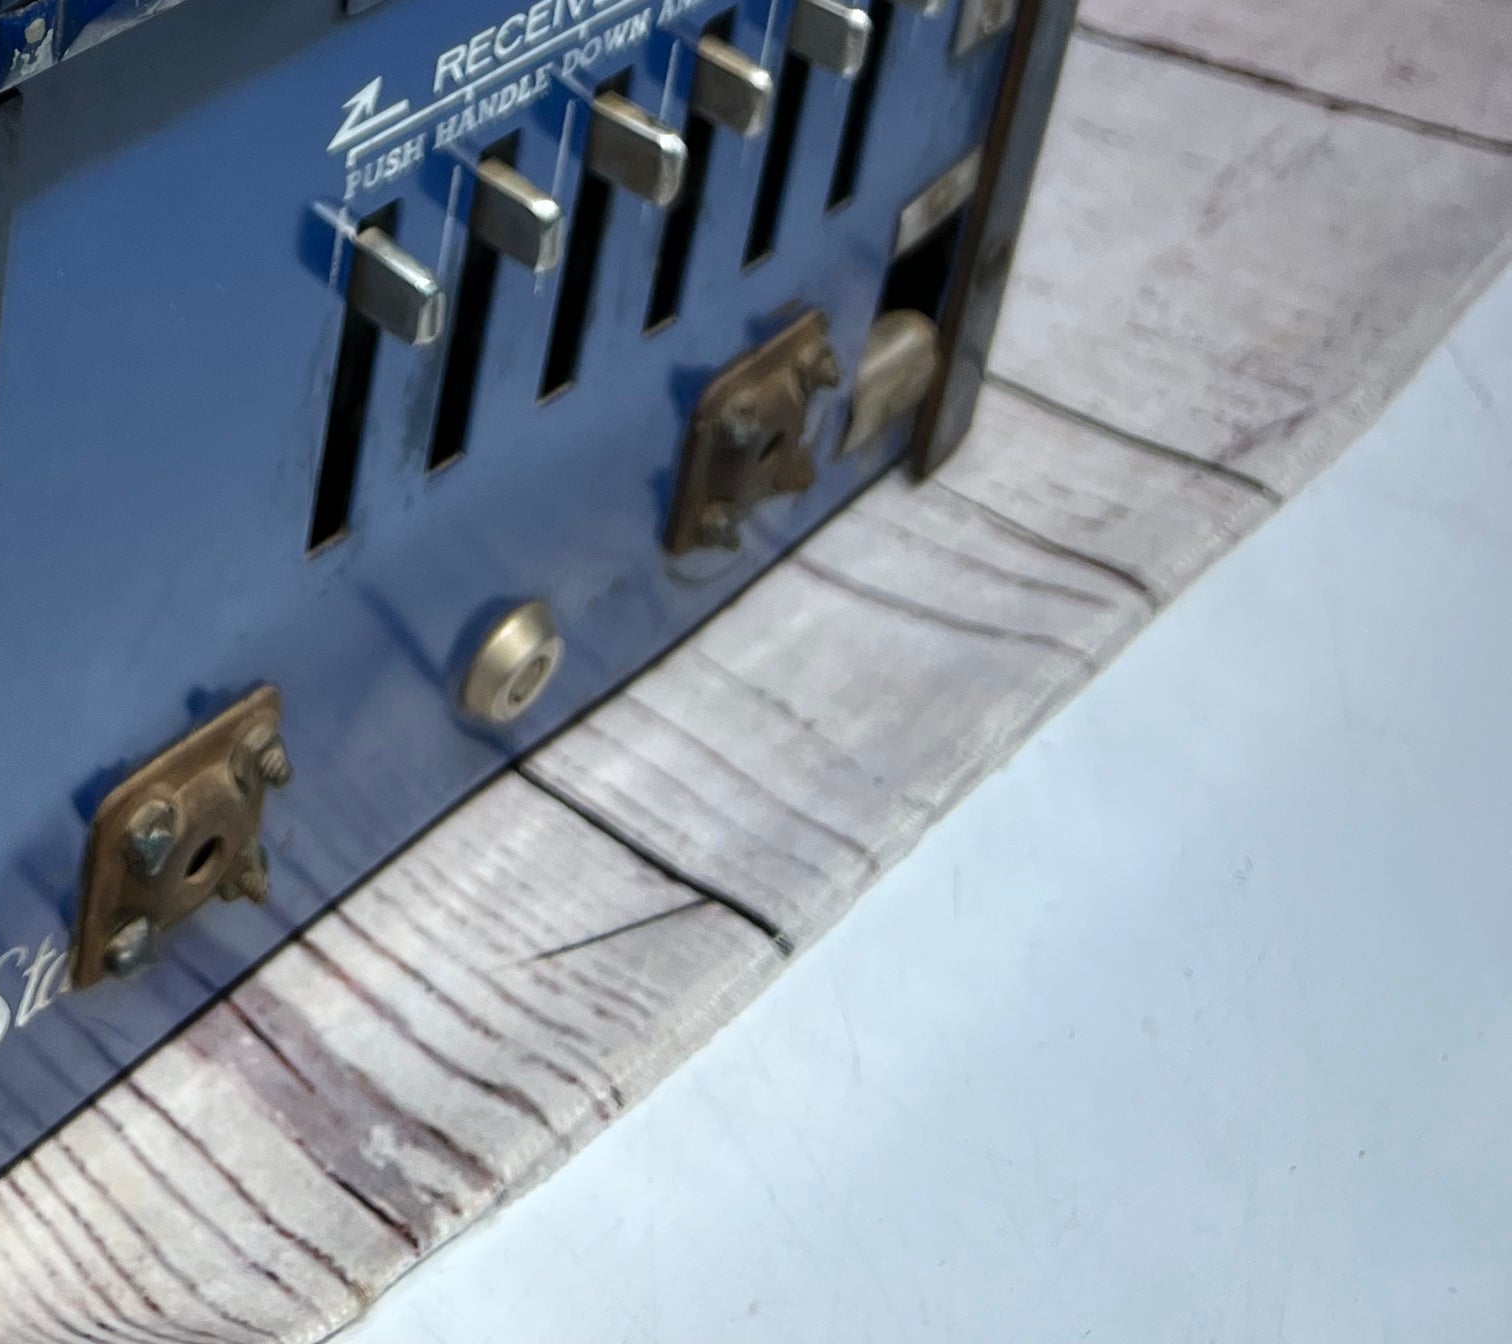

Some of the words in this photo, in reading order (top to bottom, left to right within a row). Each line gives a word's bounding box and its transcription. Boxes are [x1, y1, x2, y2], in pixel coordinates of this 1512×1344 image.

[343, 132, 428, 201] PUSH
[432, 62, 554, 151] HANDLE
[561, 9, 652, 77] DOWN
